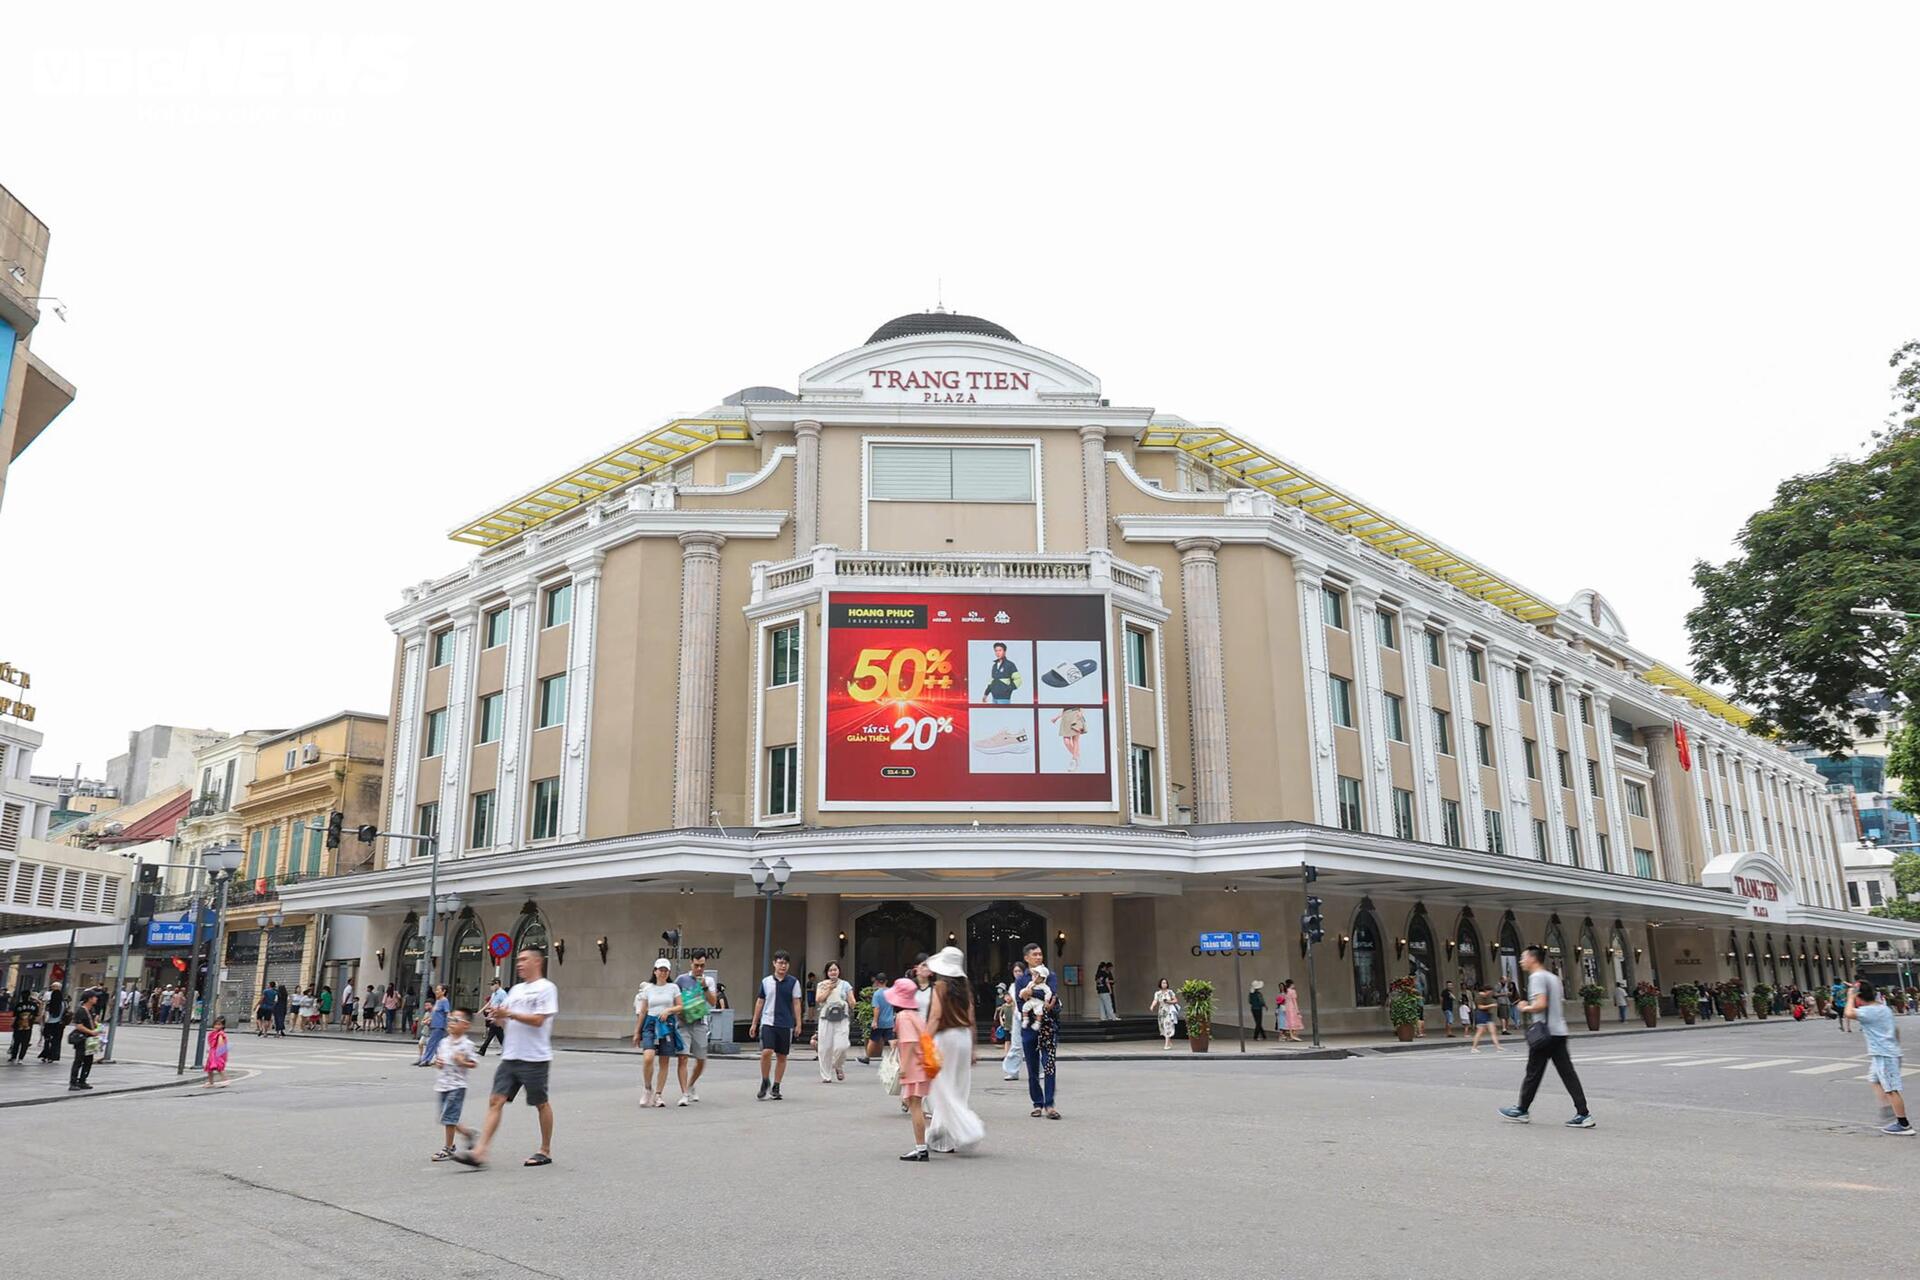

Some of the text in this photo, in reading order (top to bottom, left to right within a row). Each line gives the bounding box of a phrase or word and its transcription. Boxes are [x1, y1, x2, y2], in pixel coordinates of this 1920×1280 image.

[869, 371, 1030, 391] TRANG TIEN
[924, 393, 976, 403] PLAZA
[848, 608, 914, 617] HOANG PHUC
[863, 724, 890, 733] TẤT CẢ
[890, 716, 953, 750] 20%
[847, 733, 890, 742] GIẢM THÊM
[1734, 875, 1778, 902] TRANG TIEN
